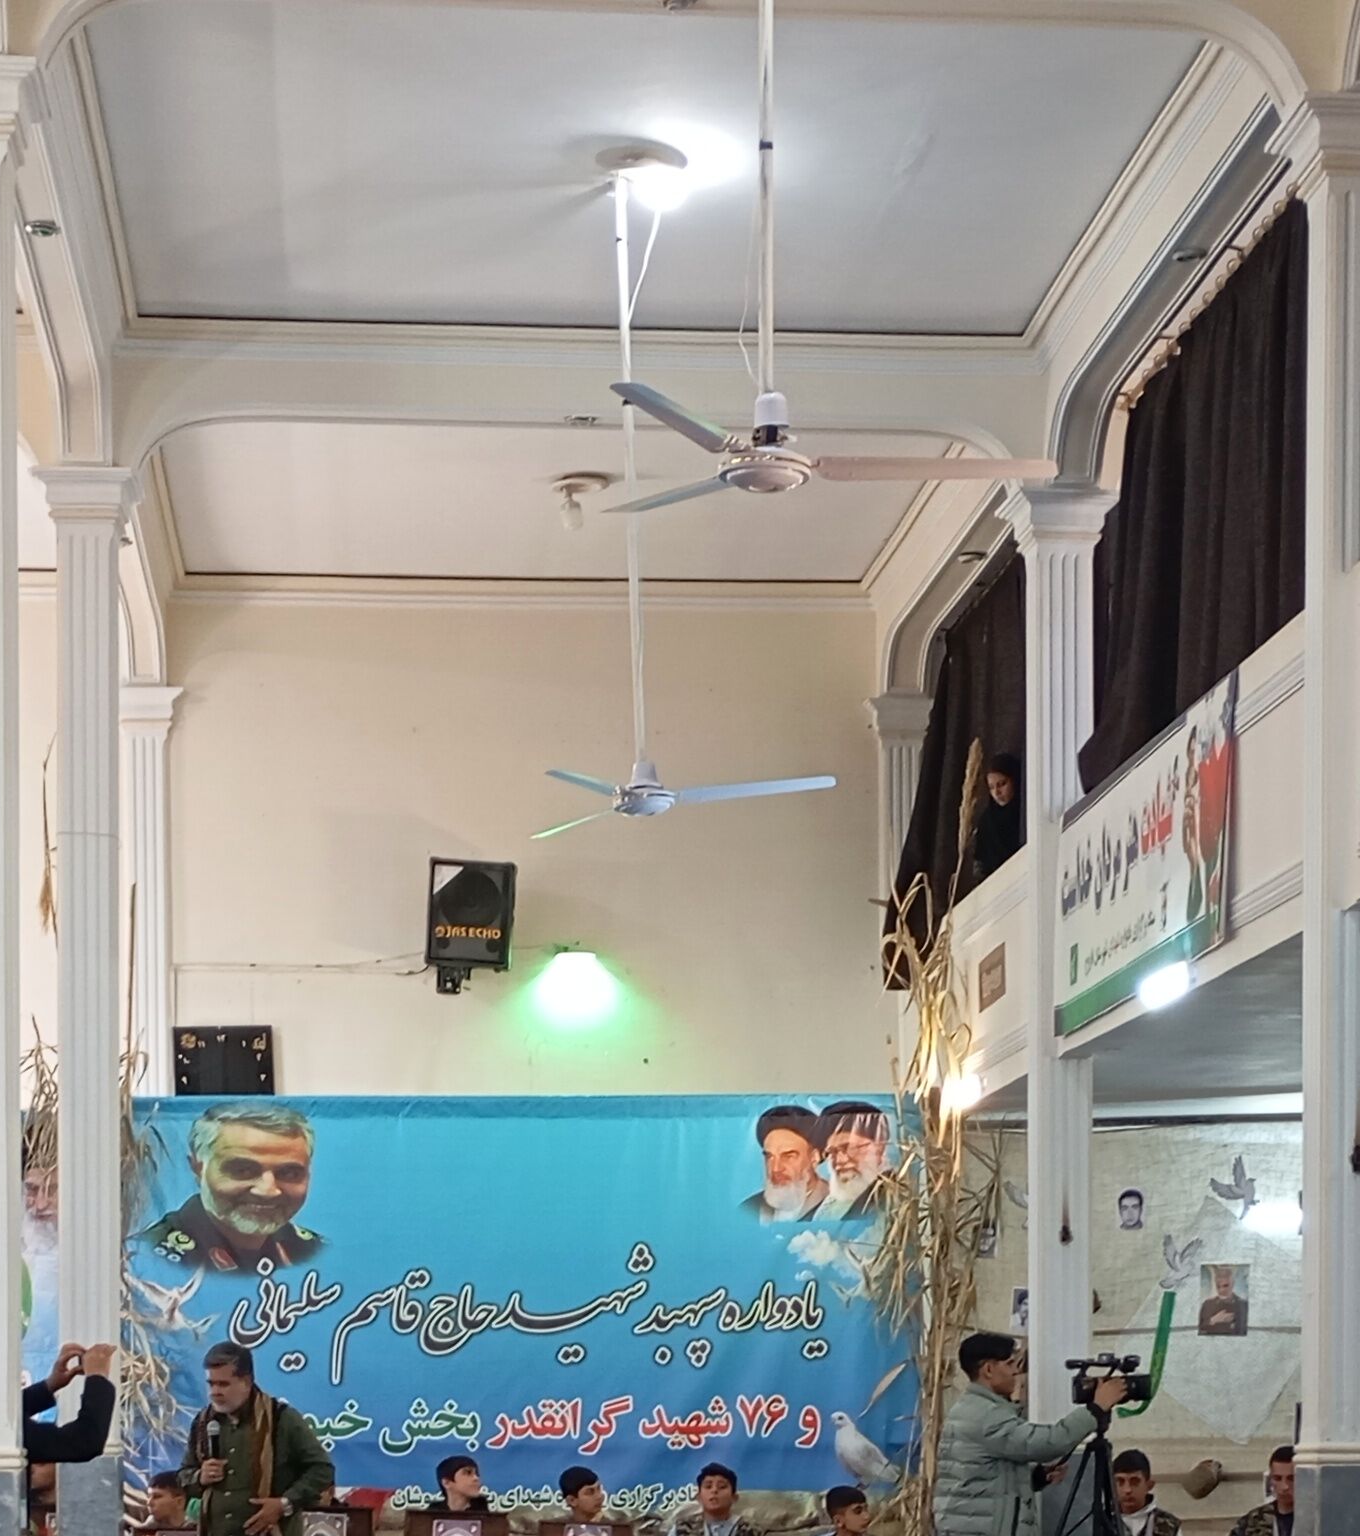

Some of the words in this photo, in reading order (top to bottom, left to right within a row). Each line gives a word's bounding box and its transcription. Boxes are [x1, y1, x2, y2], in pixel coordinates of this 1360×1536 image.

[227, 1256, 343, 1372] سلیمانی
[330, 1267, 431, 1386] قاسم
[419, 1283, 498, 1356] حاج
[492, 1241, 655, 1365] شهید
[633, 1287, 727, 1368] سپهبد
[720, 1280, 829, 1361] یادواره
[378, 1397, 482, 1457] بخش
[639, 1395, 734, 1450] شهید
[737, 1394, 789, 1438] ۷۶
[795, 1404, 822, 1448] و
[498, 1484, 553, 1512] شهدای
